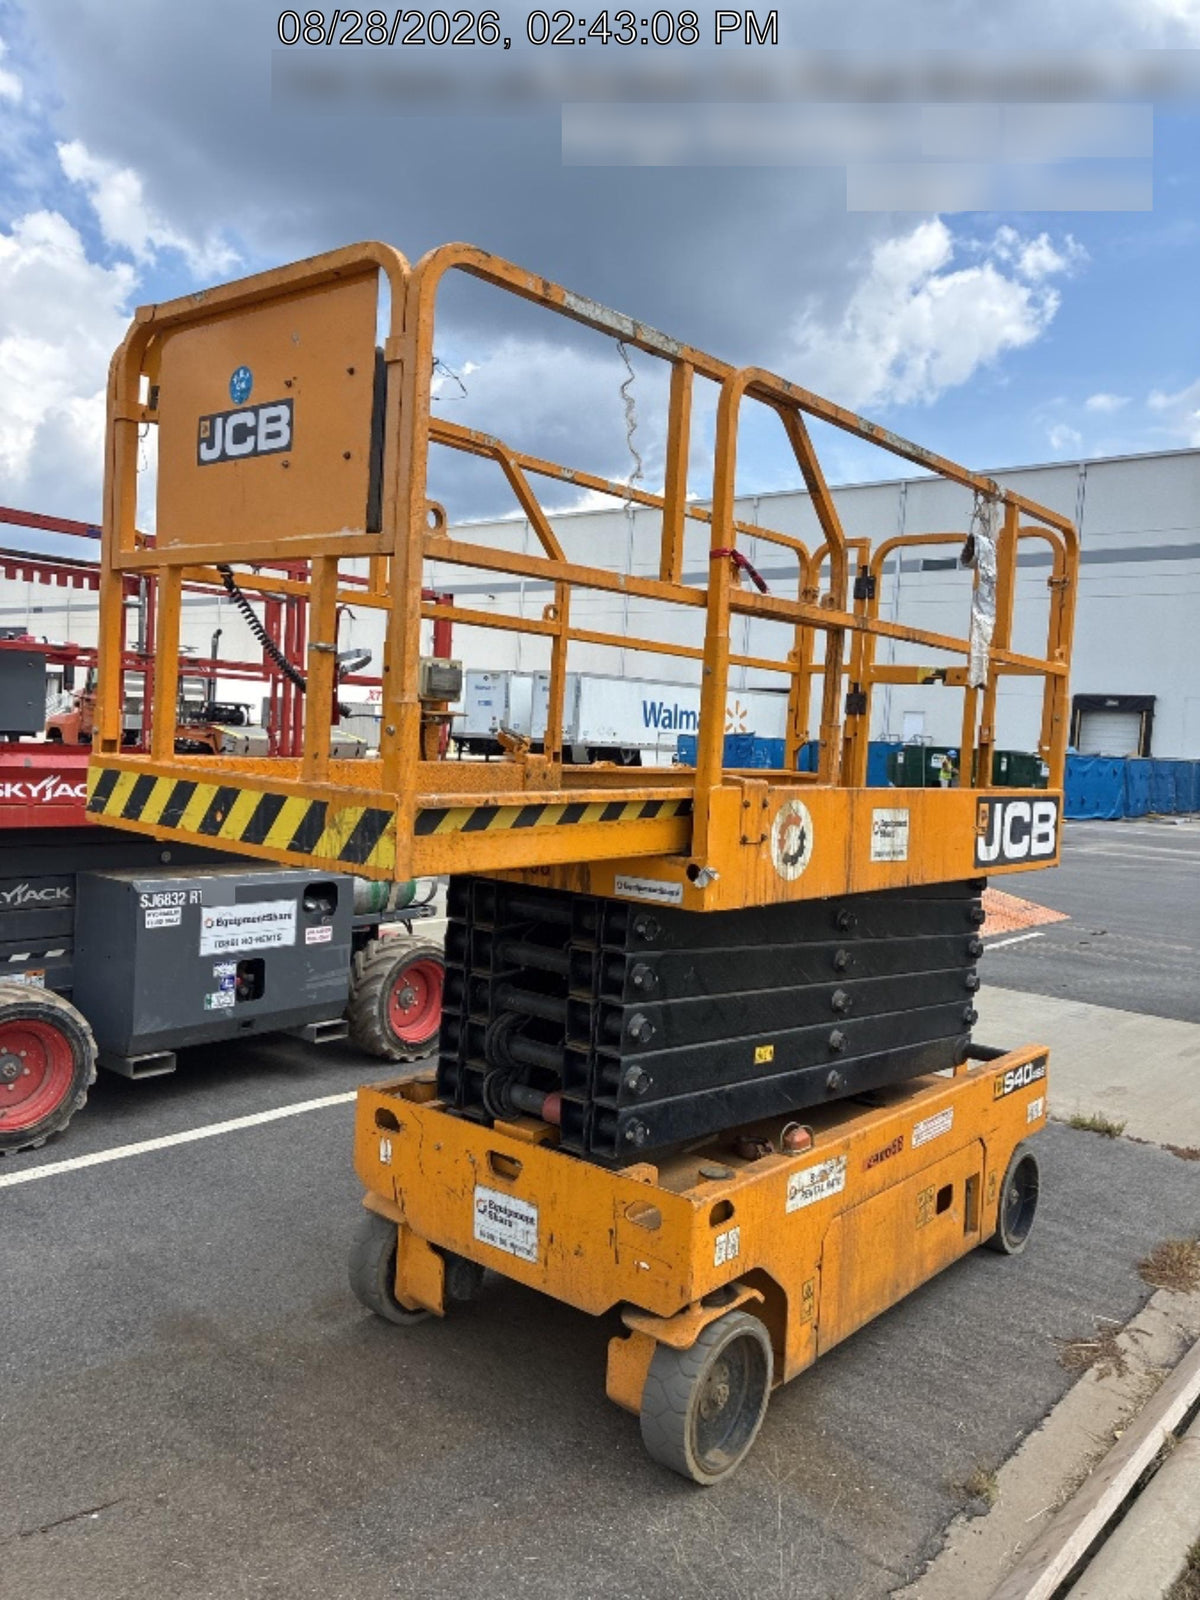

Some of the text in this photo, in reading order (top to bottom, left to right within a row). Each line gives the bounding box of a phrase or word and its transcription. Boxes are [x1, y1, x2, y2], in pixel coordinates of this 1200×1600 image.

[200, 405, 291, 461] JCB
[643, 700, 701, 731] Walm
[0, 775, 87, 802] KYJAC
[977, 801, 1057, 861] JCB
[0, 883, 71, 905] YJACK
[140, 892, 186, 908] SJ6832
[216, 912, 292, 928] EquipmentShare
